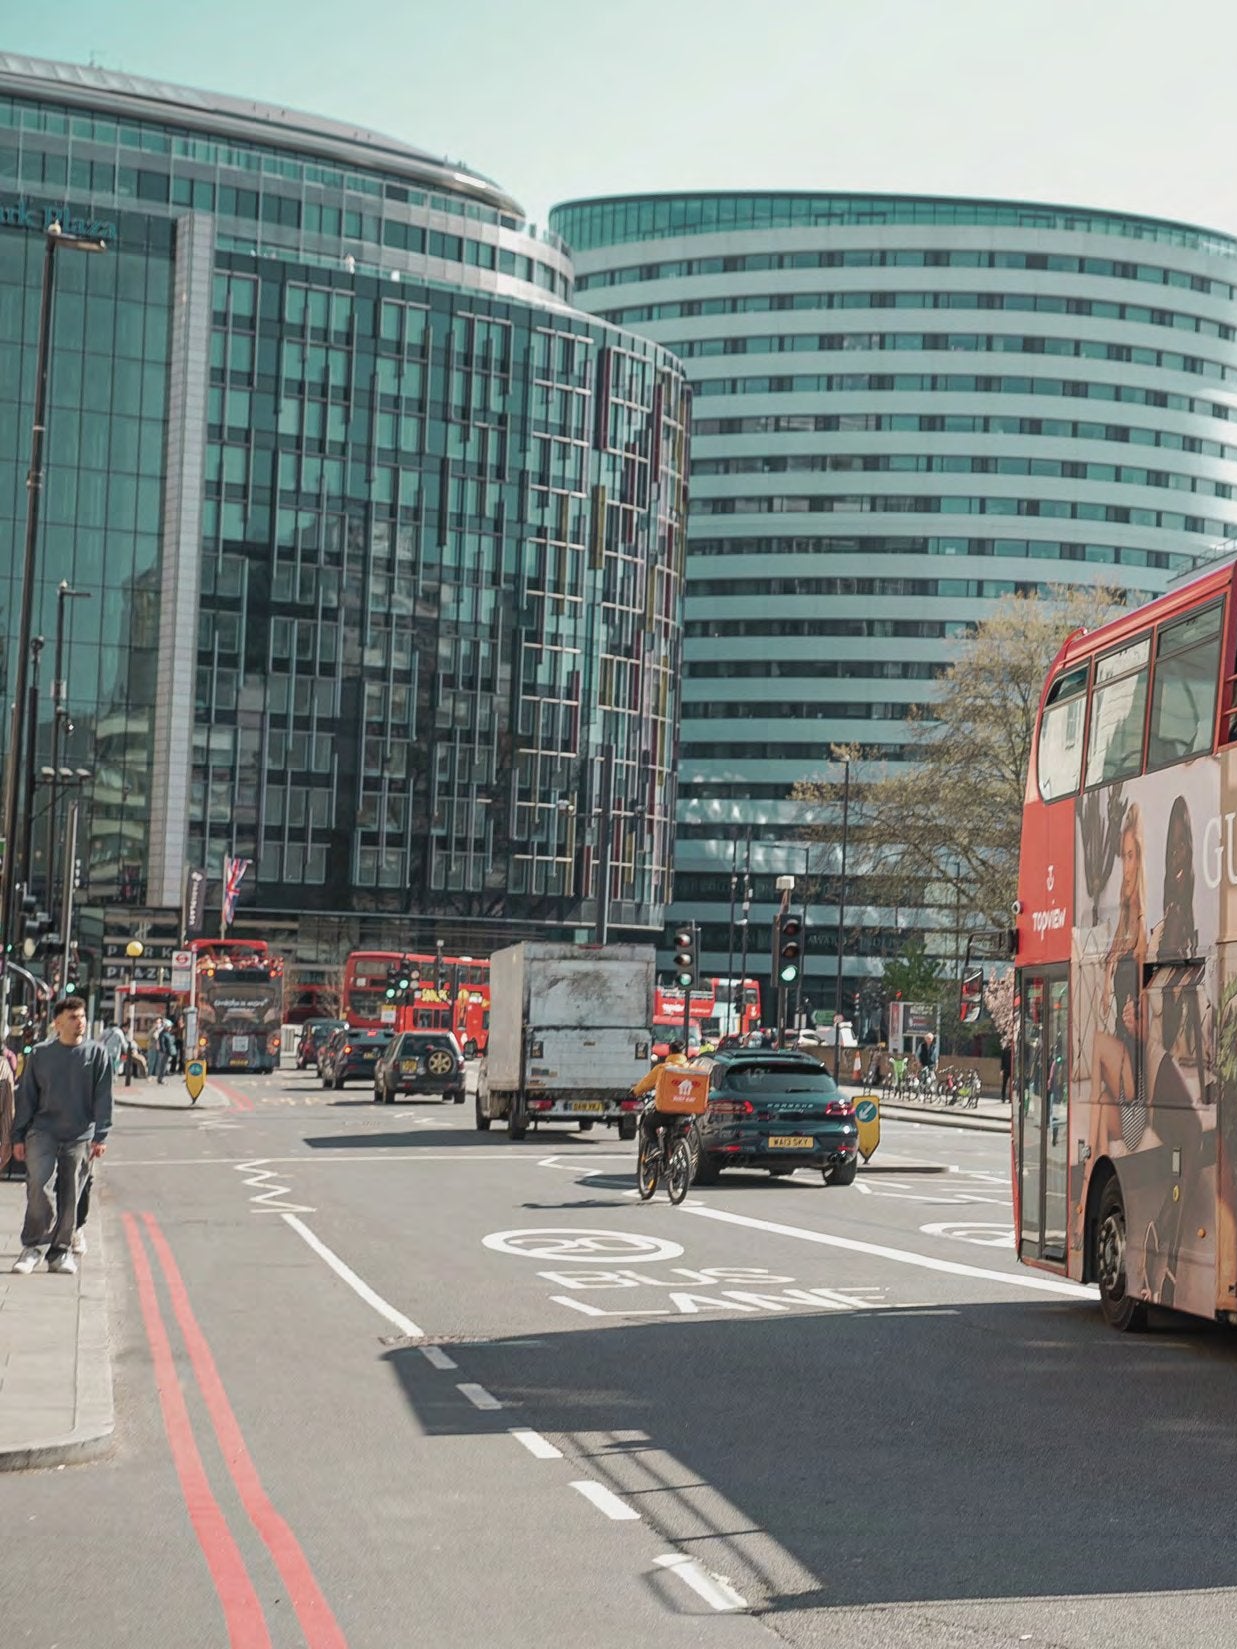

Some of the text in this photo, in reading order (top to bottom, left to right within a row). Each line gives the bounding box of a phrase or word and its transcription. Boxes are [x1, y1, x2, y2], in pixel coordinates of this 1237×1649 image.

[107, 944, 172, 958] PRK
[536, 1267, 796, 1289] BUS
[549, 1287, 888, 1315] LANE
